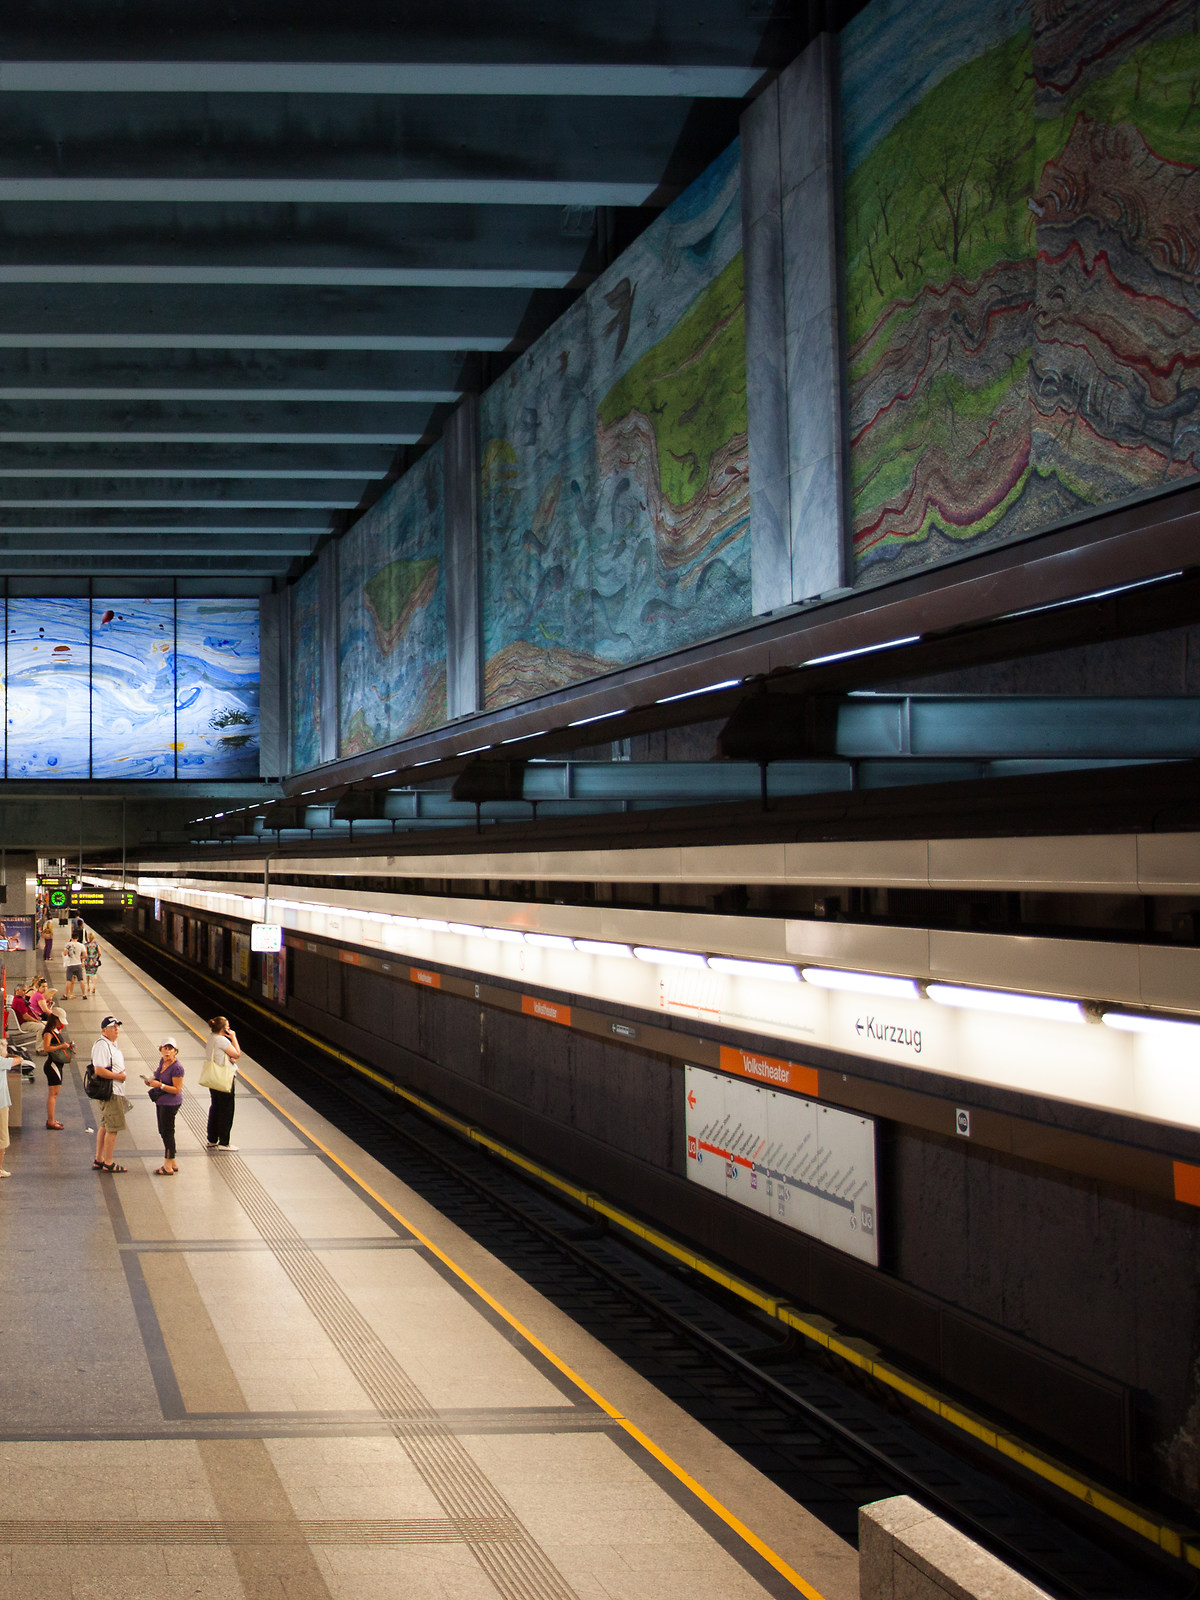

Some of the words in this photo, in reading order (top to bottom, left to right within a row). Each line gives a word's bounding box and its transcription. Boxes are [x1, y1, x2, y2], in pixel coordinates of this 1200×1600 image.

[866, 1015, 922, 1053] Kurzzug
[742, 1055, 790, 1083] Volkstheater
[861, 1210, 872, 1229] U3
